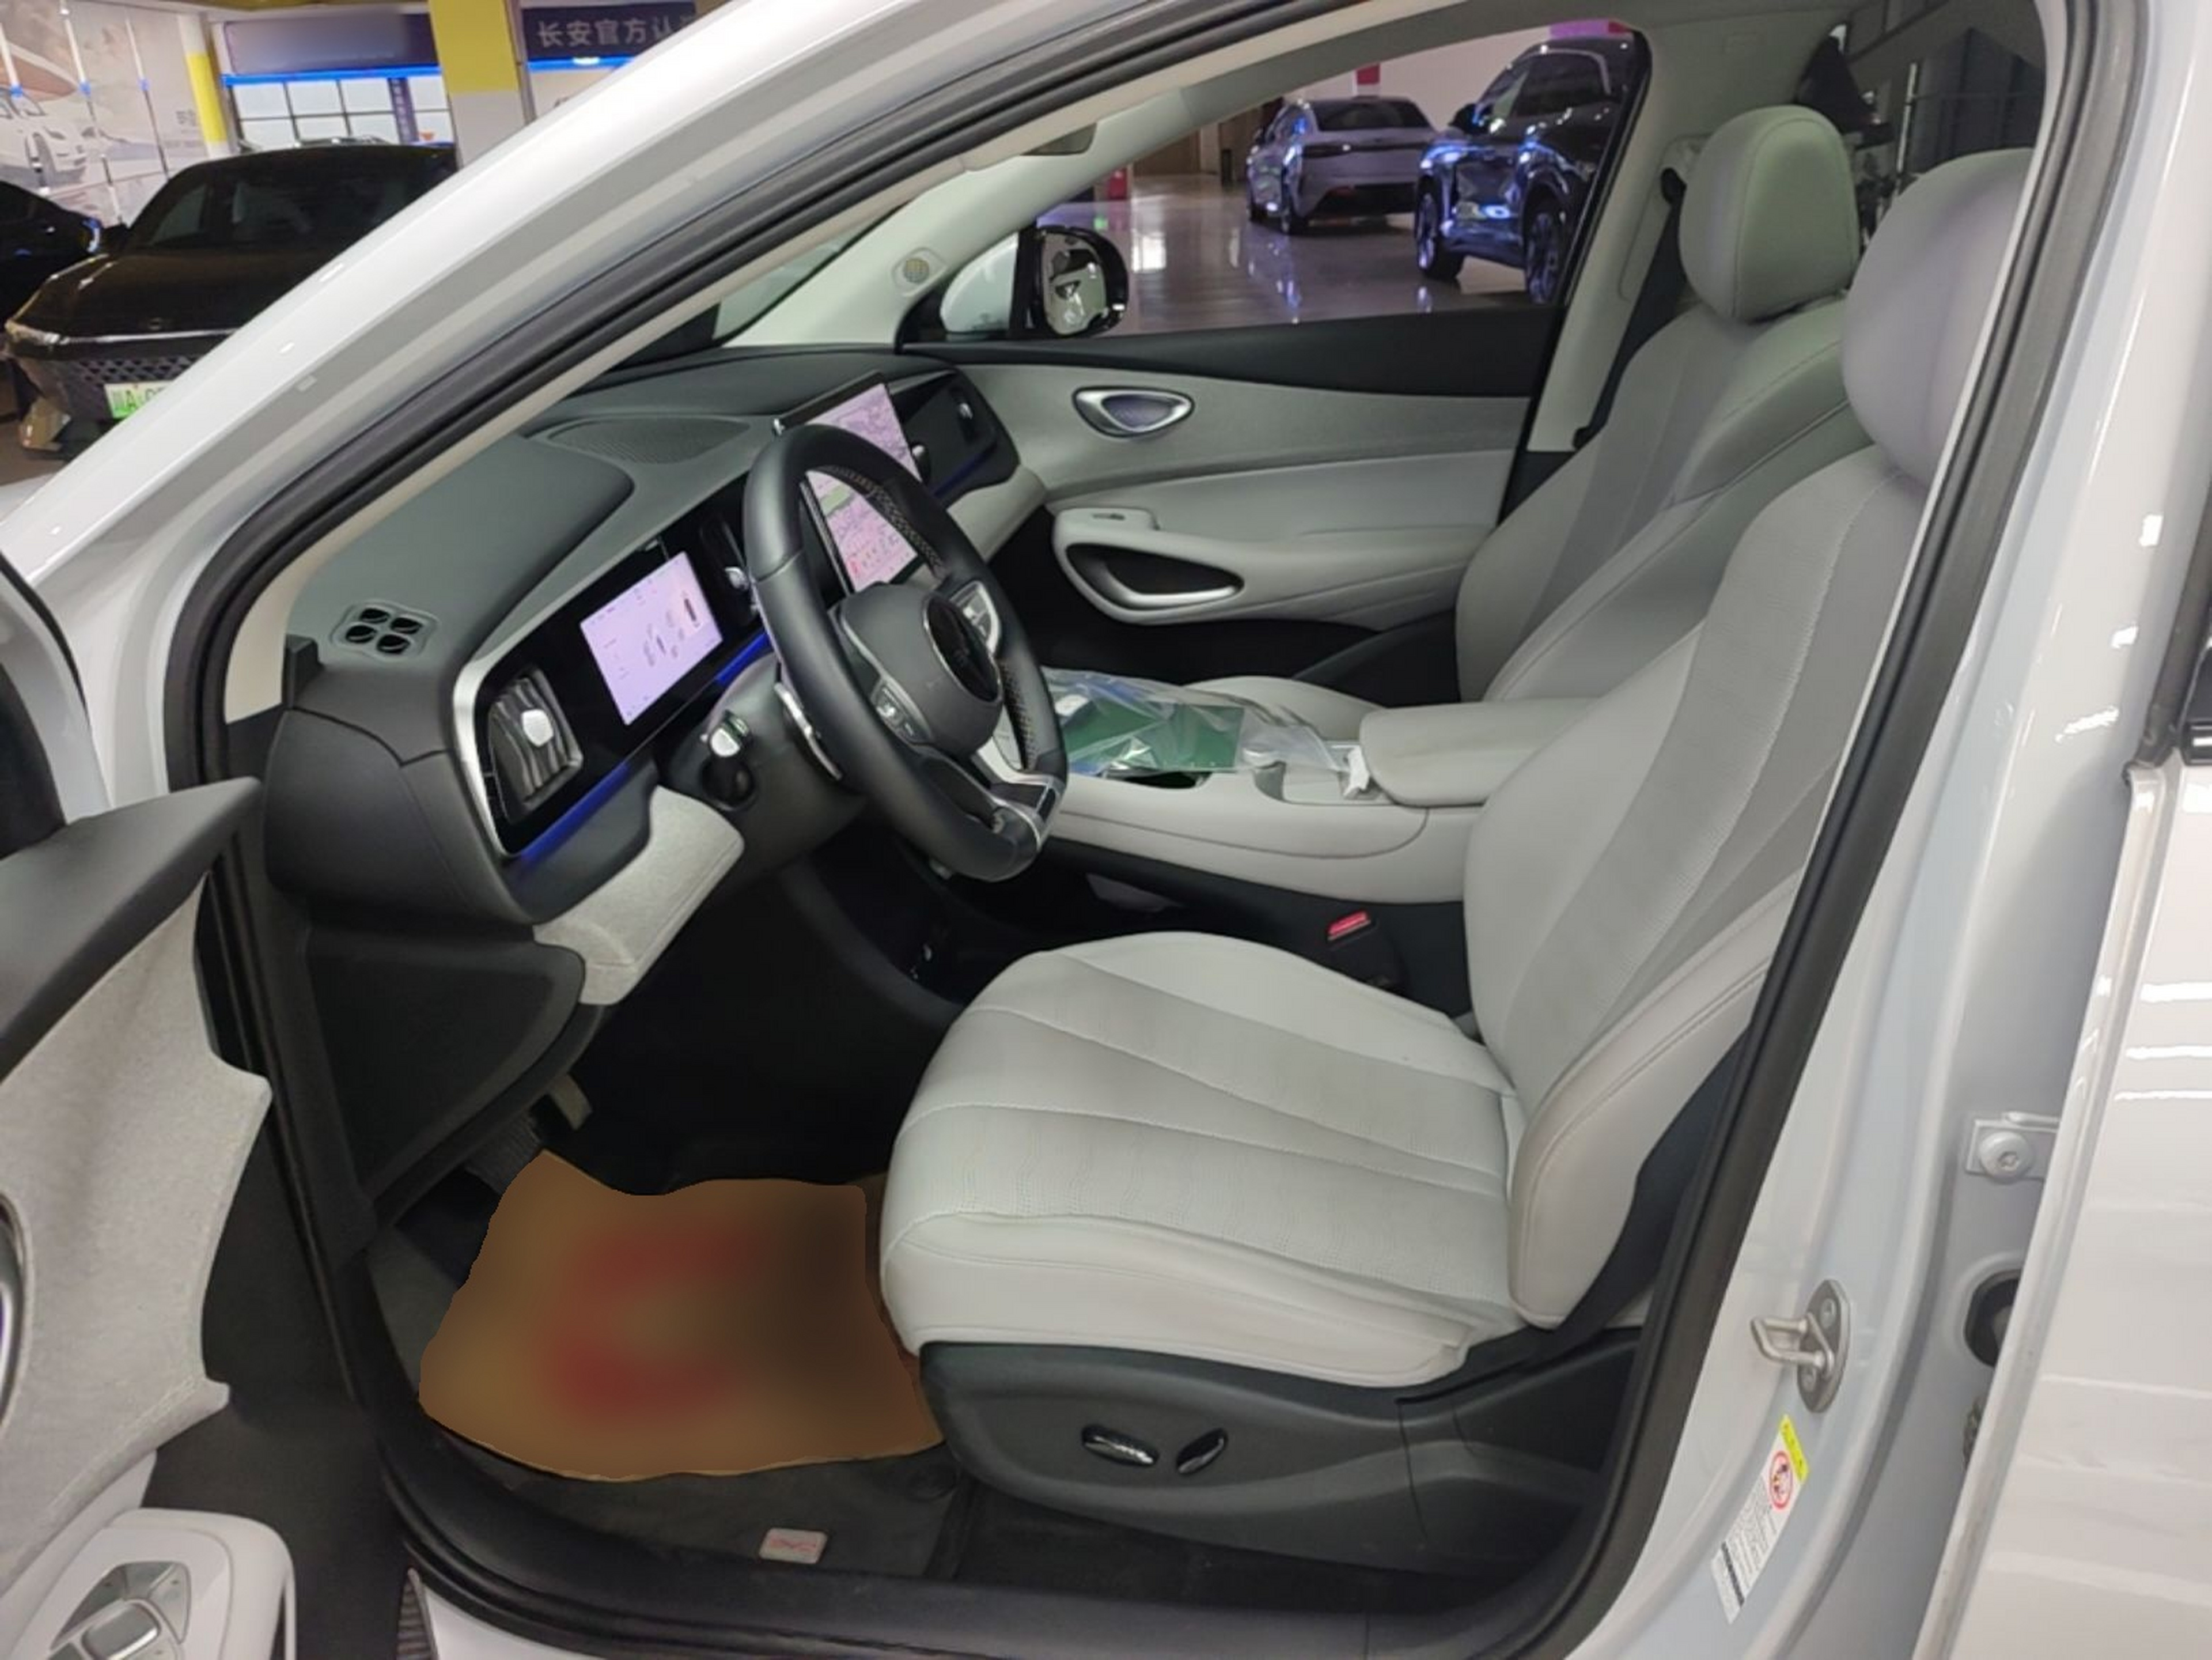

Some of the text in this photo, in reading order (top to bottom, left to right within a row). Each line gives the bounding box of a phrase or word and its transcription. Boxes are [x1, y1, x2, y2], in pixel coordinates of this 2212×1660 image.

[537, 16, 693, 47] 长安官方认
